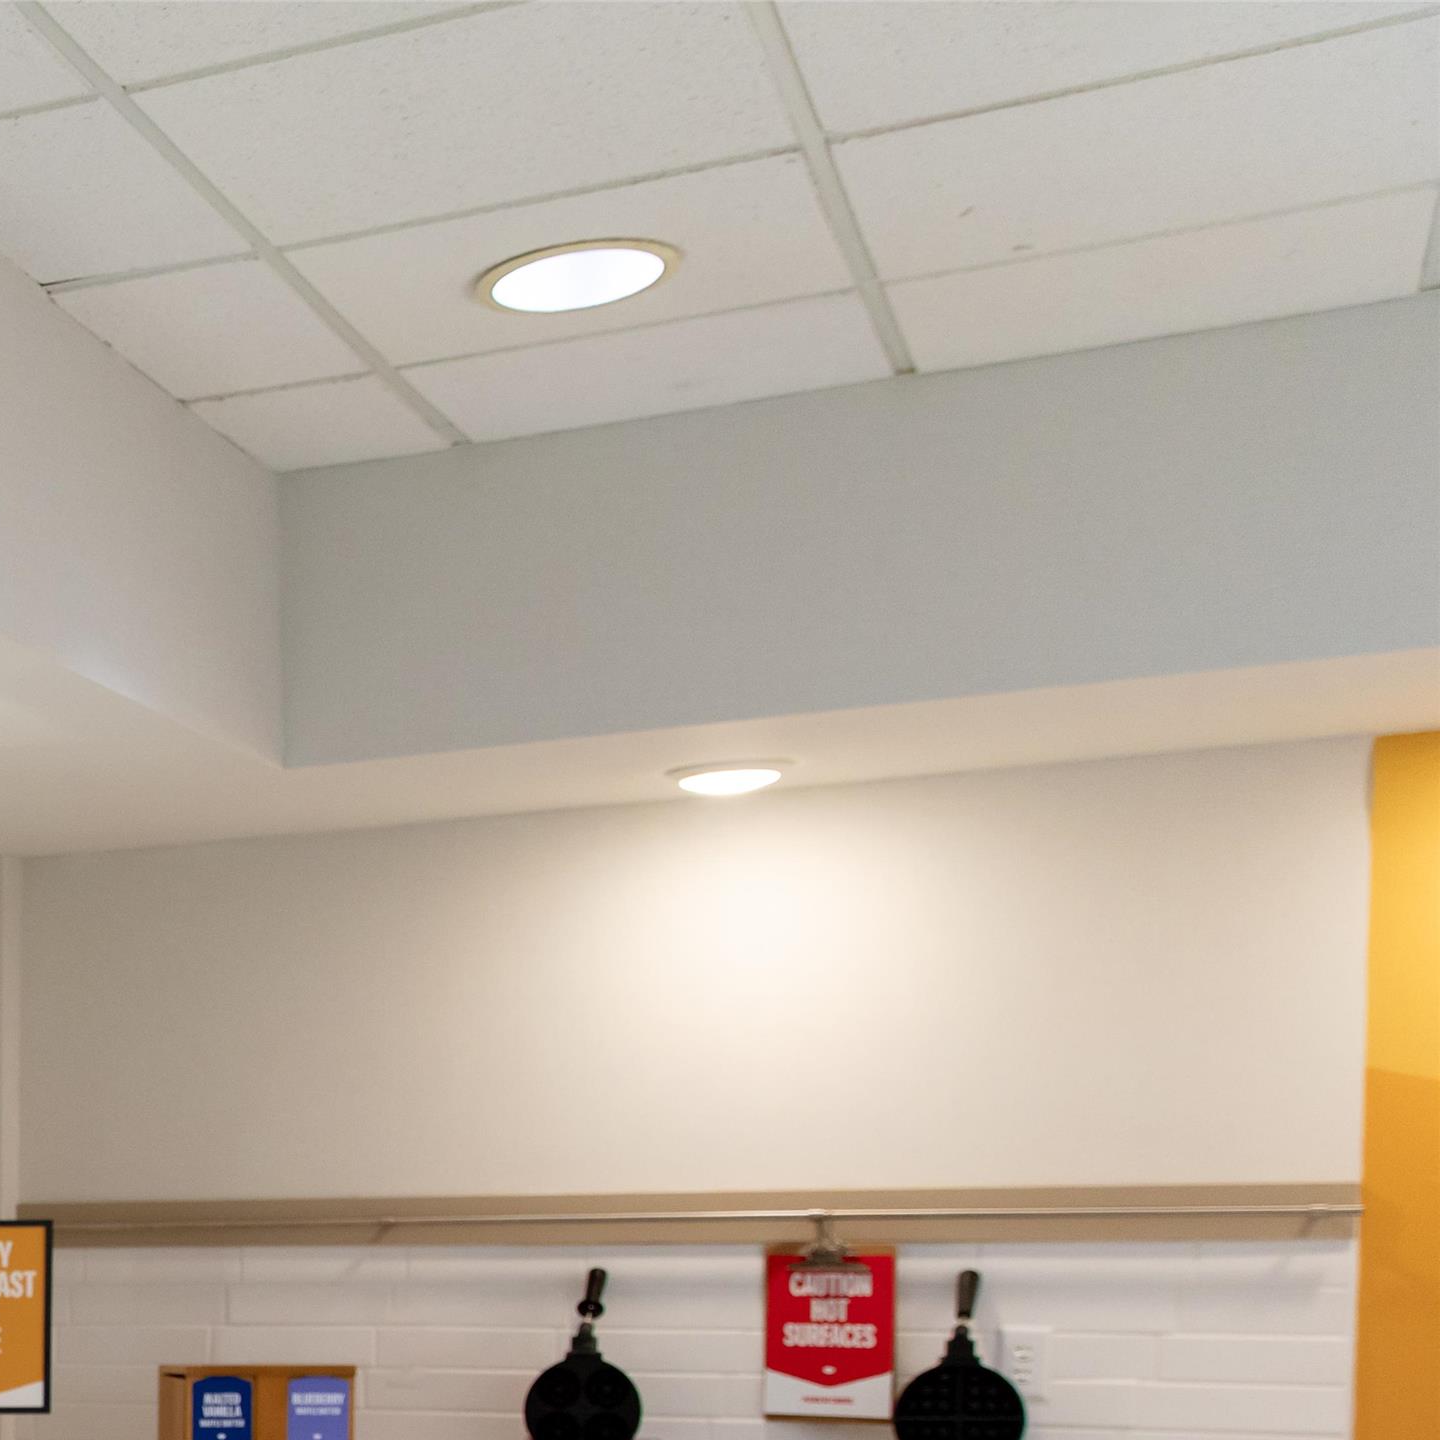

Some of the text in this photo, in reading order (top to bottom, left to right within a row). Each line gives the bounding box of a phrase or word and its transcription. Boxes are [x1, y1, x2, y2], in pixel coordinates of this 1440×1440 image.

[789, 1270, 874, 1298] CAUTION
[809, 1297, 851, 1323] HOT
[782, 1321, 878, 1349] SURFACES
